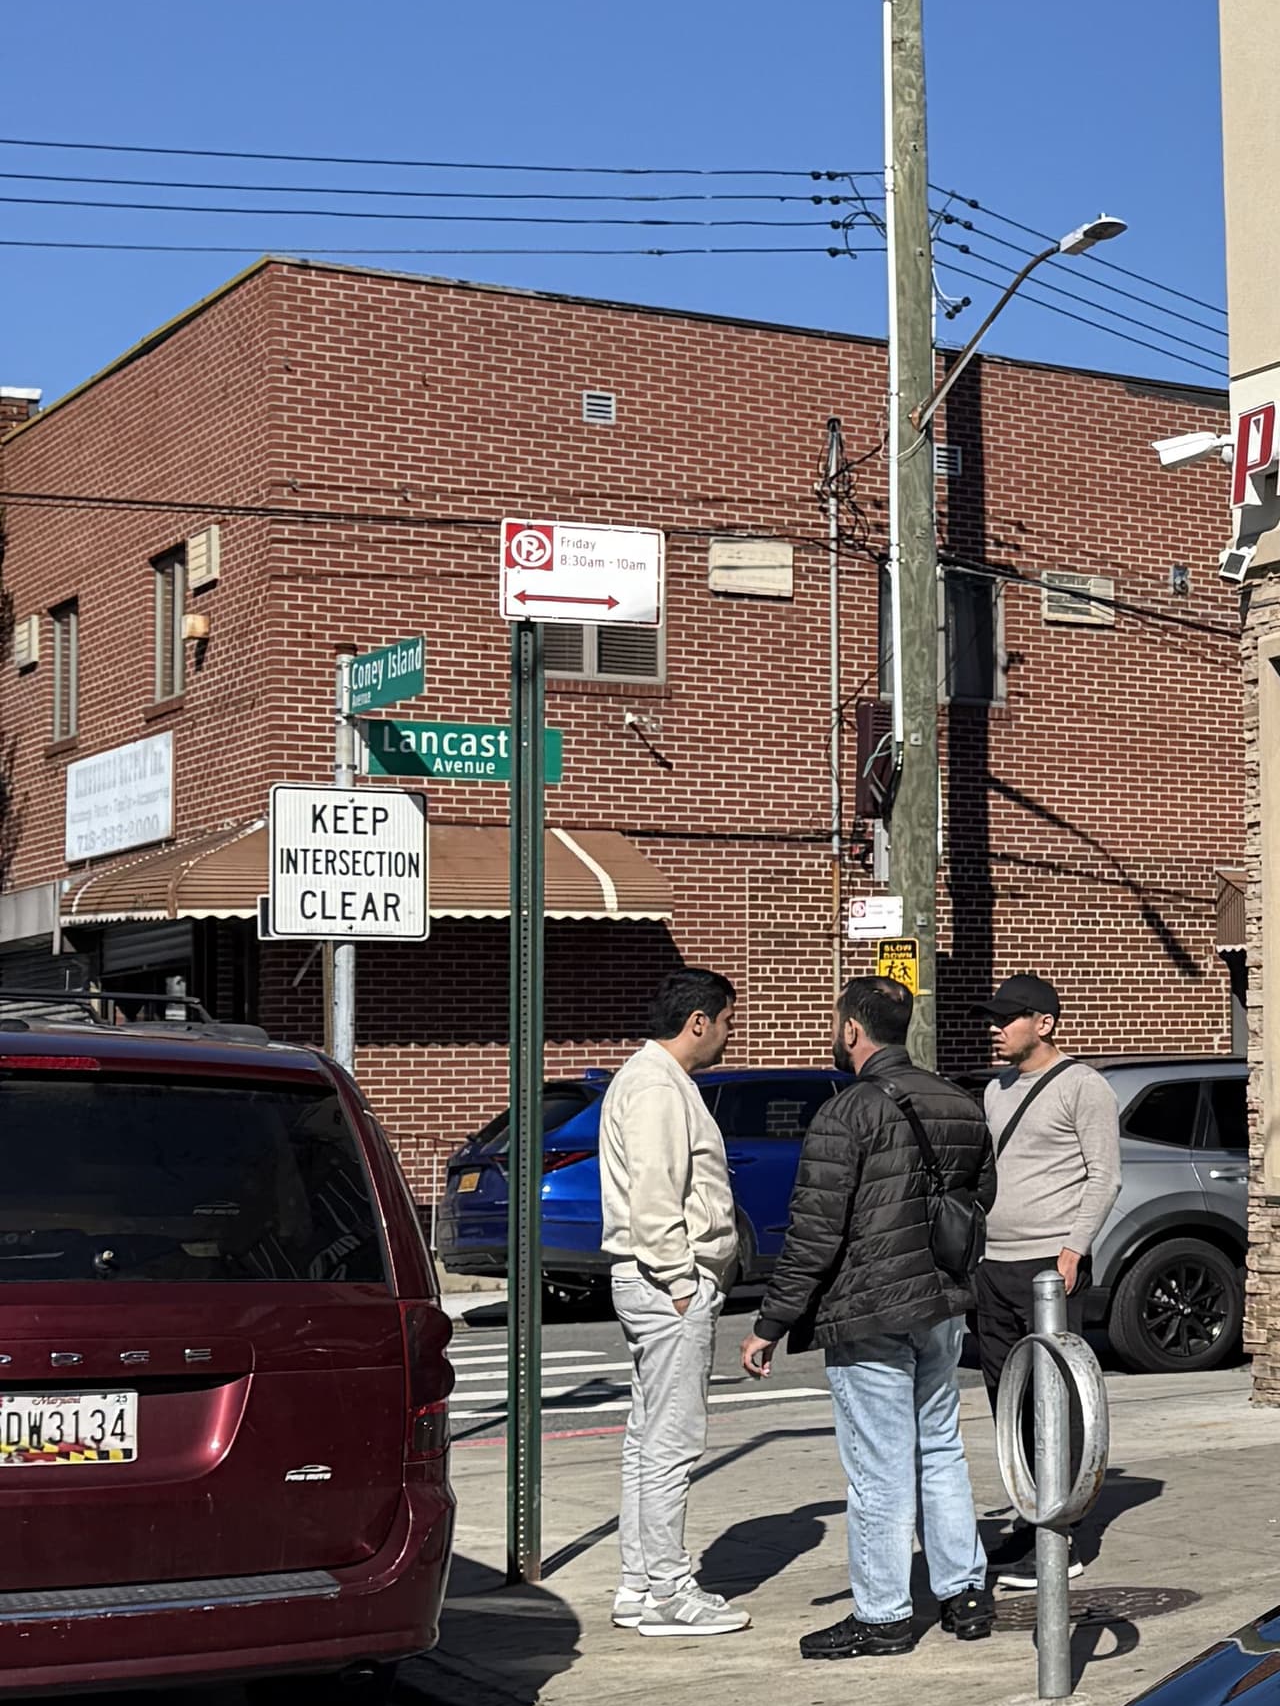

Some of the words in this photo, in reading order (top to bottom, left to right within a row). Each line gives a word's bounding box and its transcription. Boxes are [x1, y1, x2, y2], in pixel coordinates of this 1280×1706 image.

[560, 537, 596, 552] Friday
[560, 555, 605, 568] 8:30am
[617, 559, 646, 571] 10am
[352, 658, 383, 690] Coney
[388, 644, 422, 679] Island
[384, 726, 508, 758] Lancast
[433, 758, 495, 775] Avenue
[312, 804, 388, 835] KEEP
[280, 848, 420, 878] INTERSECTION
[301, 890, 400, 922] CLEAR
[0, 1408, 127, 1446] DW3134
